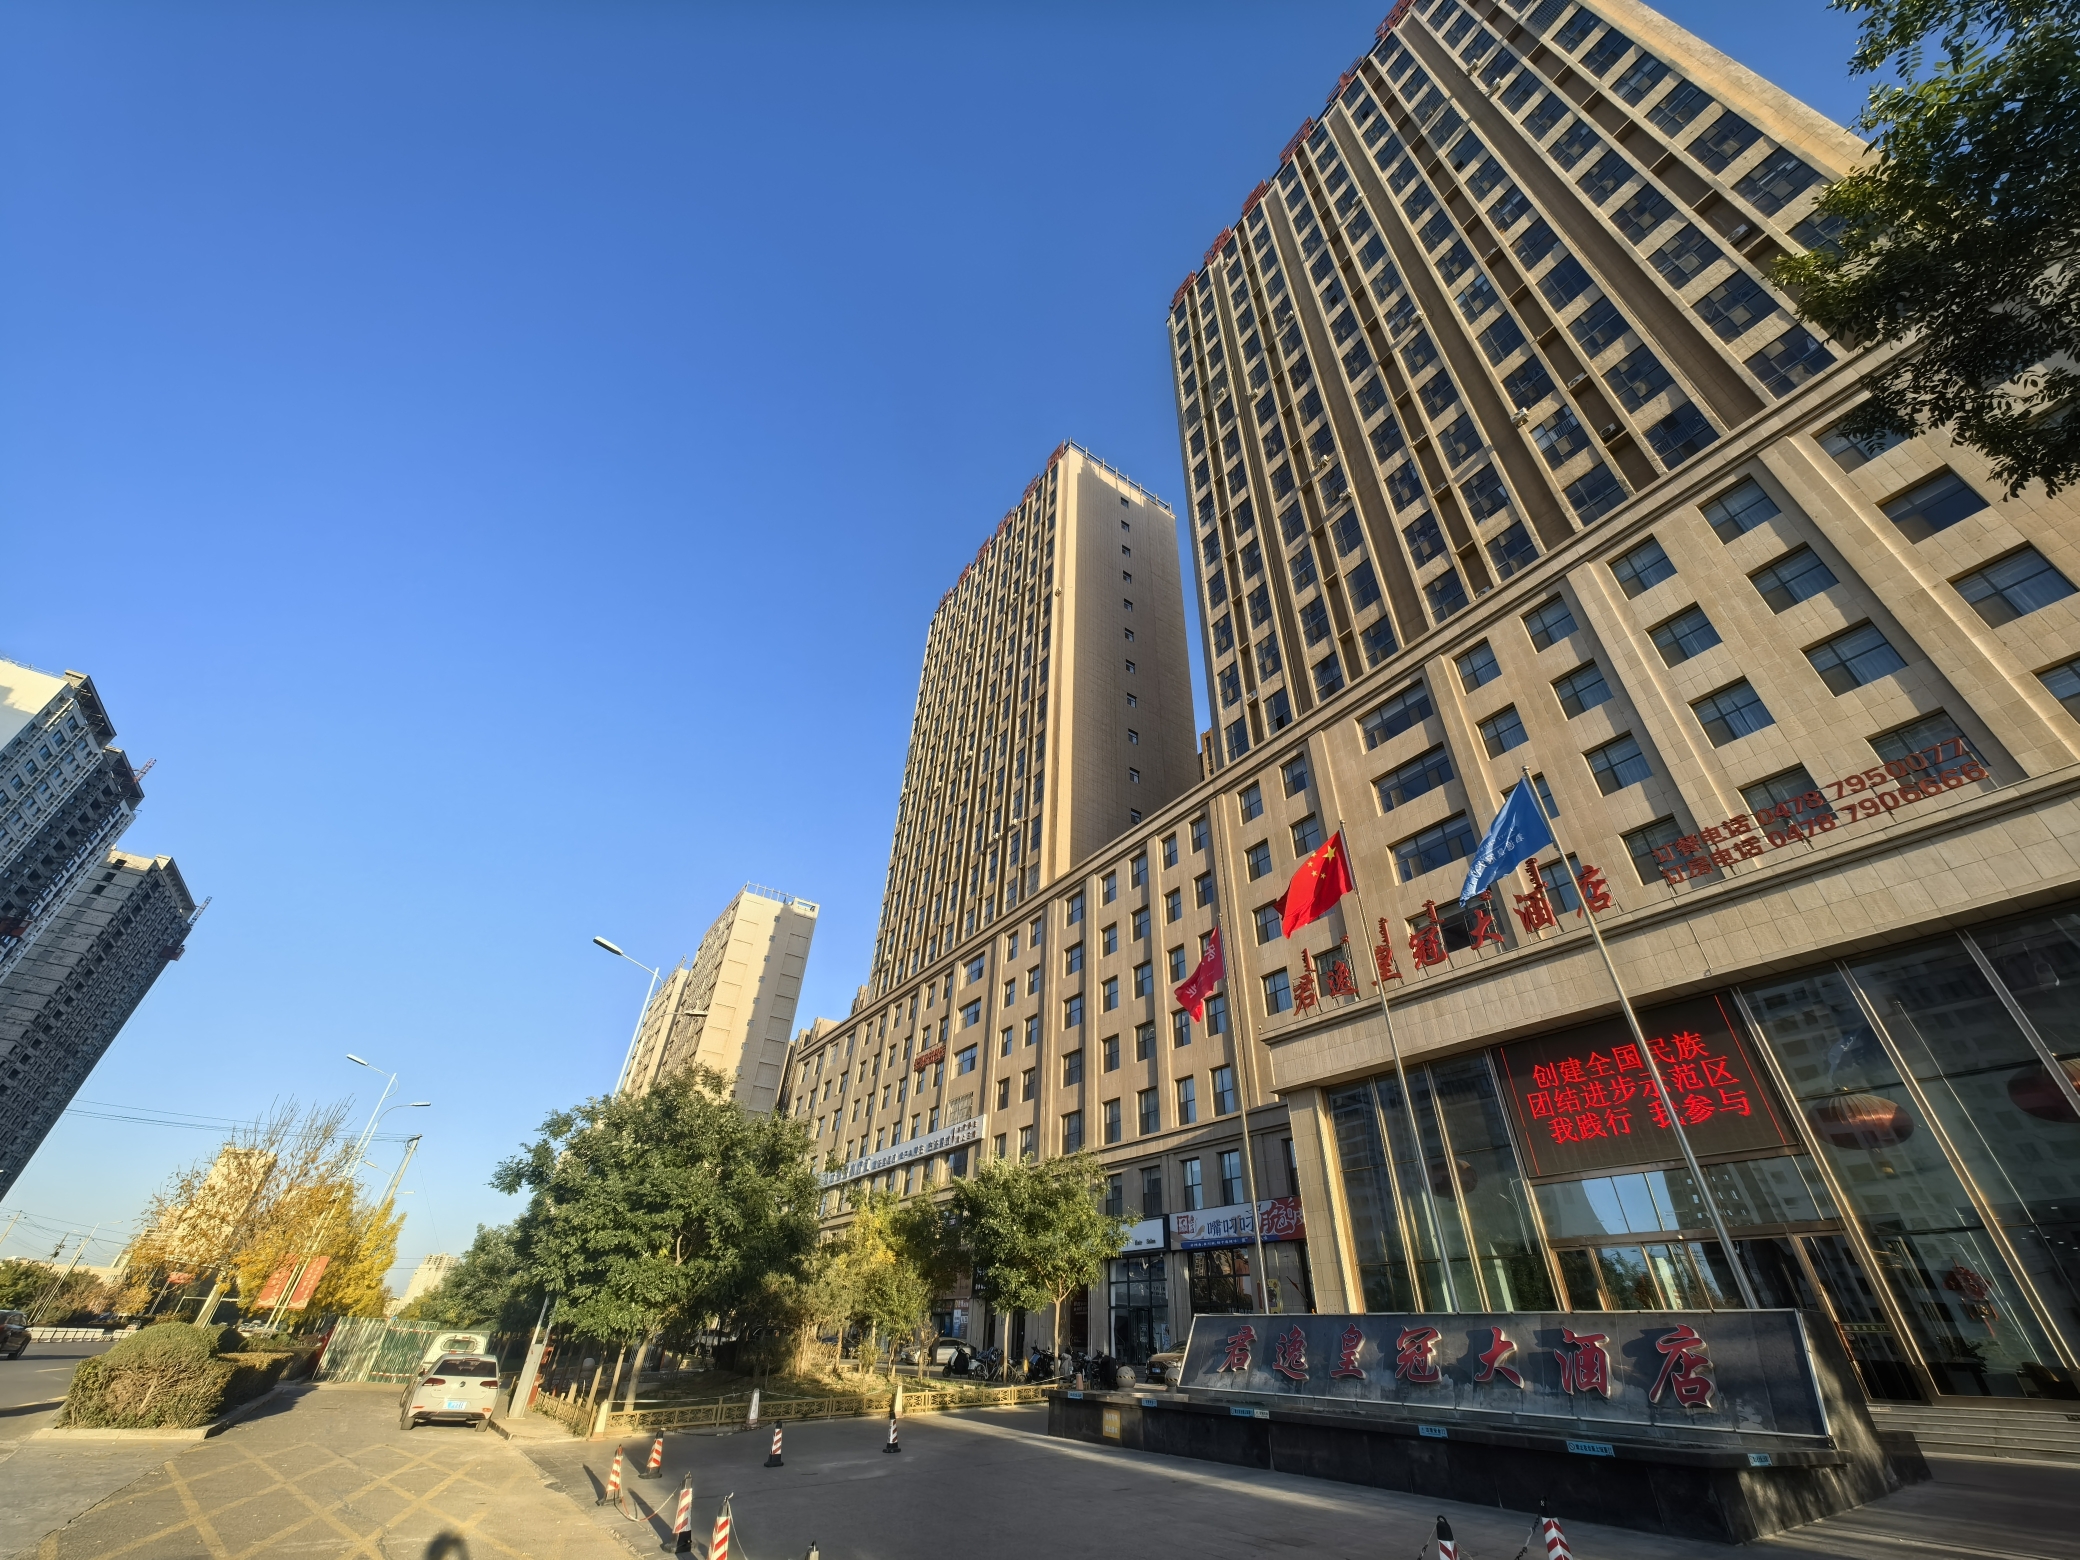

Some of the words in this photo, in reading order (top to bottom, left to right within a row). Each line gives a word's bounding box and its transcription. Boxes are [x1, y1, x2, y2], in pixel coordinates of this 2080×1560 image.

[1652, 814, 1752, 863] 订餐电话
[1755, 791, 1824, 825] 0478
[1826, 736, 1963, 799] 7950077
[1662, 835, 1764, 885] 订房电话
[1767, 813, 1836, 848] 0478
[1840, 761, 1986, 823] 7906666
[1293, 864, 1611, 1017] 君逸皇冠大酒店
[1526, 1056, 1740, 1119] 团结进步示范区
[1532, 1030, 1710, 1089] 创建全国民族
[1548, 1107, 1632, 1144] 我践行
[1649, 1089, 1751, 1129] 我参与
[1216, 1323, 1714, 1408] 君逸皇冠大酒店
